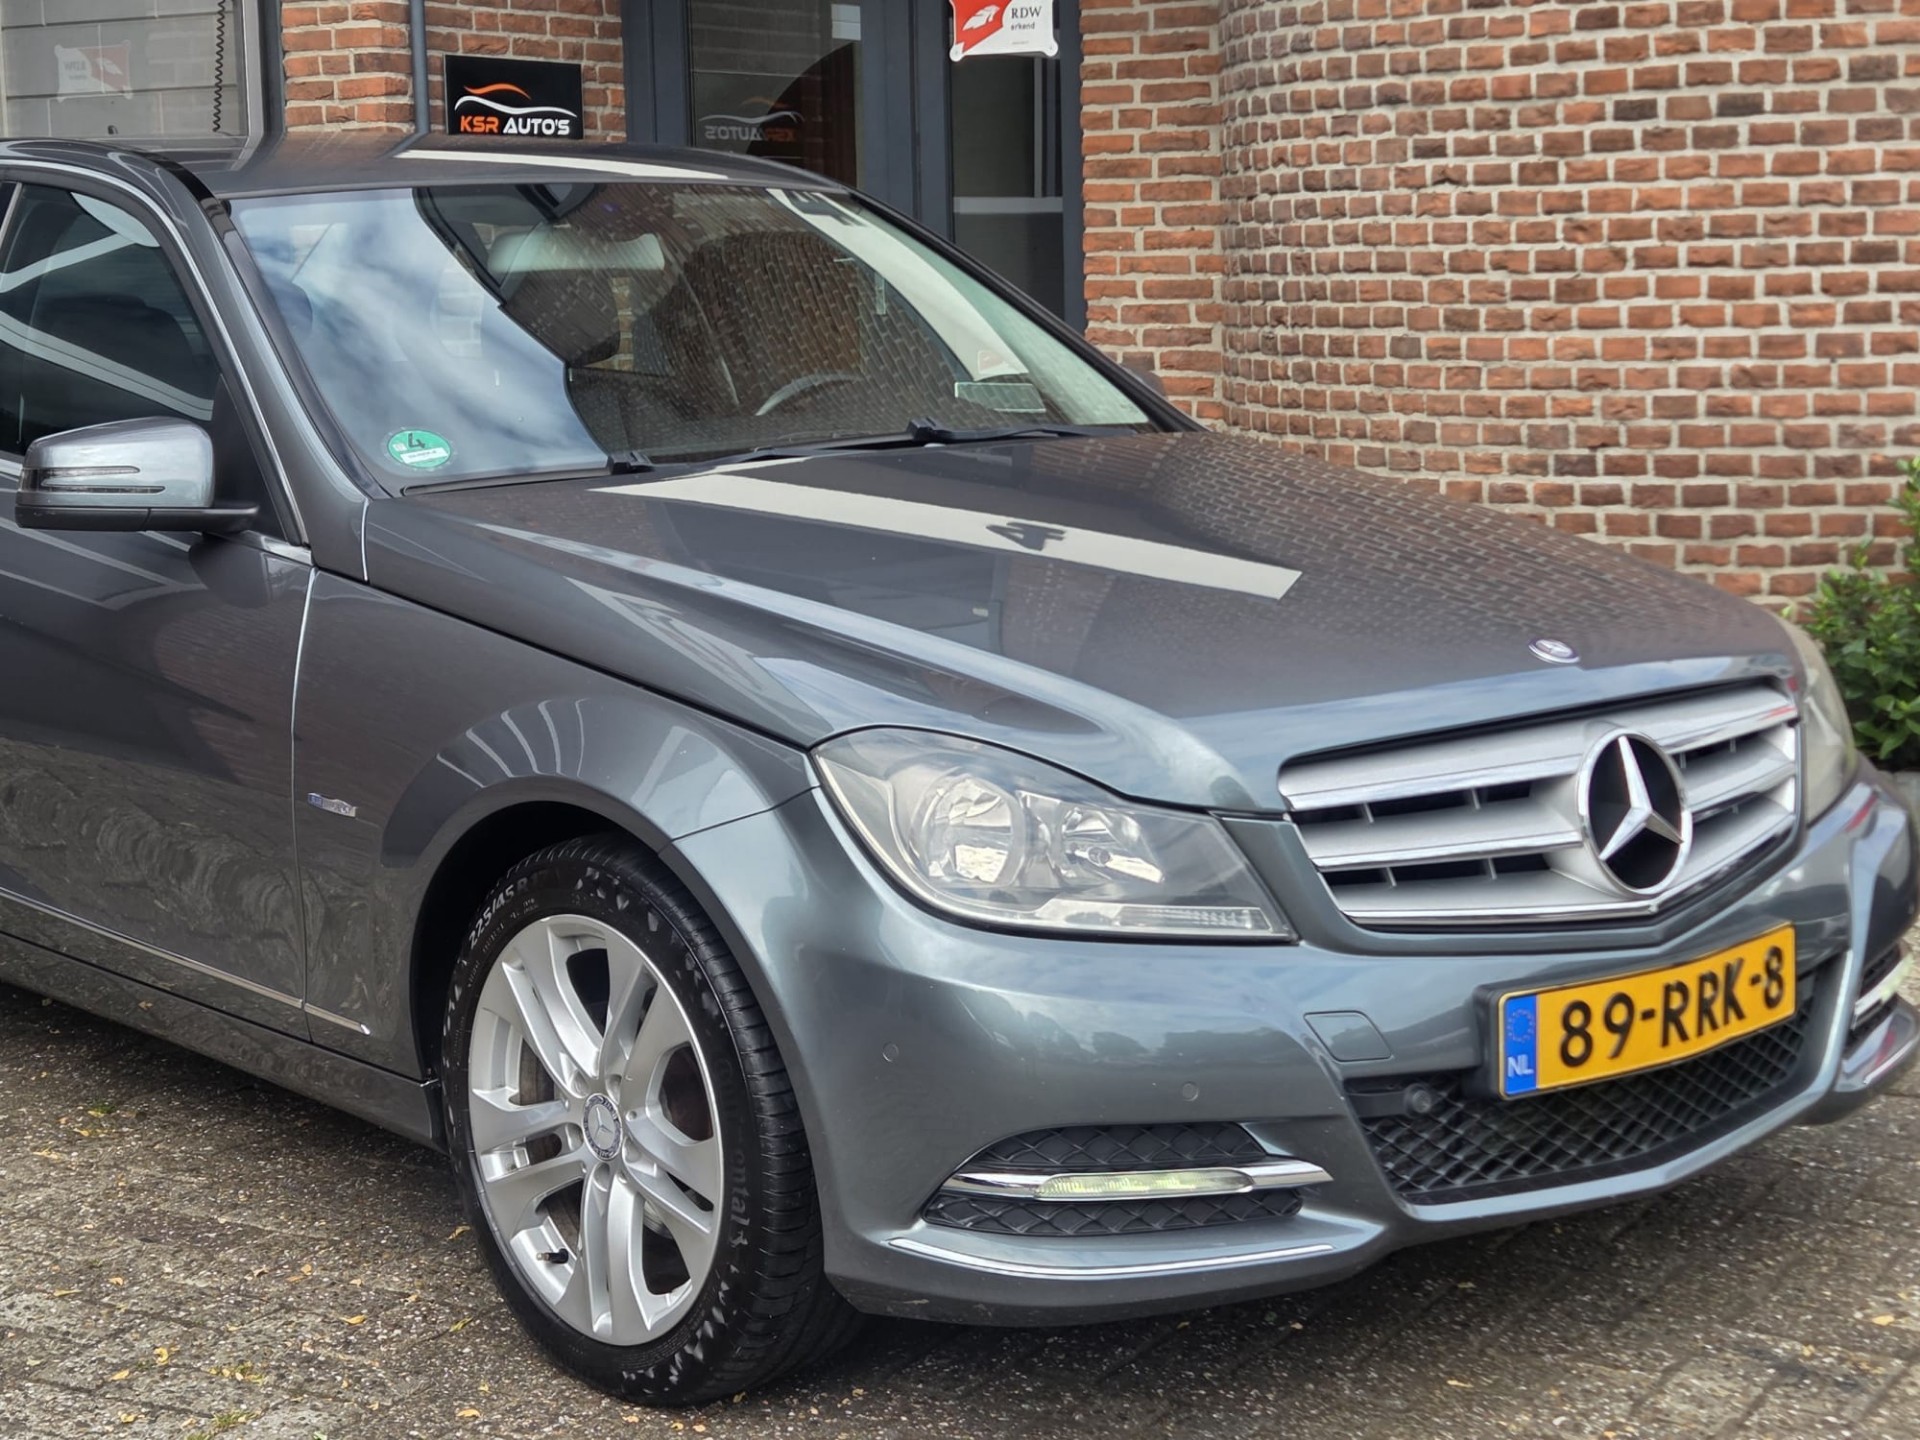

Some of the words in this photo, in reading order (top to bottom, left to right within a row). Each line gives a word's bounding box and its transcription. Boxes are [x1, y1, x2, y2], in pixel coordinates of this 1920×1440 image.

[1011, 6, 1042, 19] RDW
[460, 115, 499, 133] KSR
[503, 117, 571, 135] AUTO'S
[407, 432, 426, 449] 4
[1559, 945, 1785, 1068] 89-RRK-8
[1507, 1055, 1534, 1078] NL
